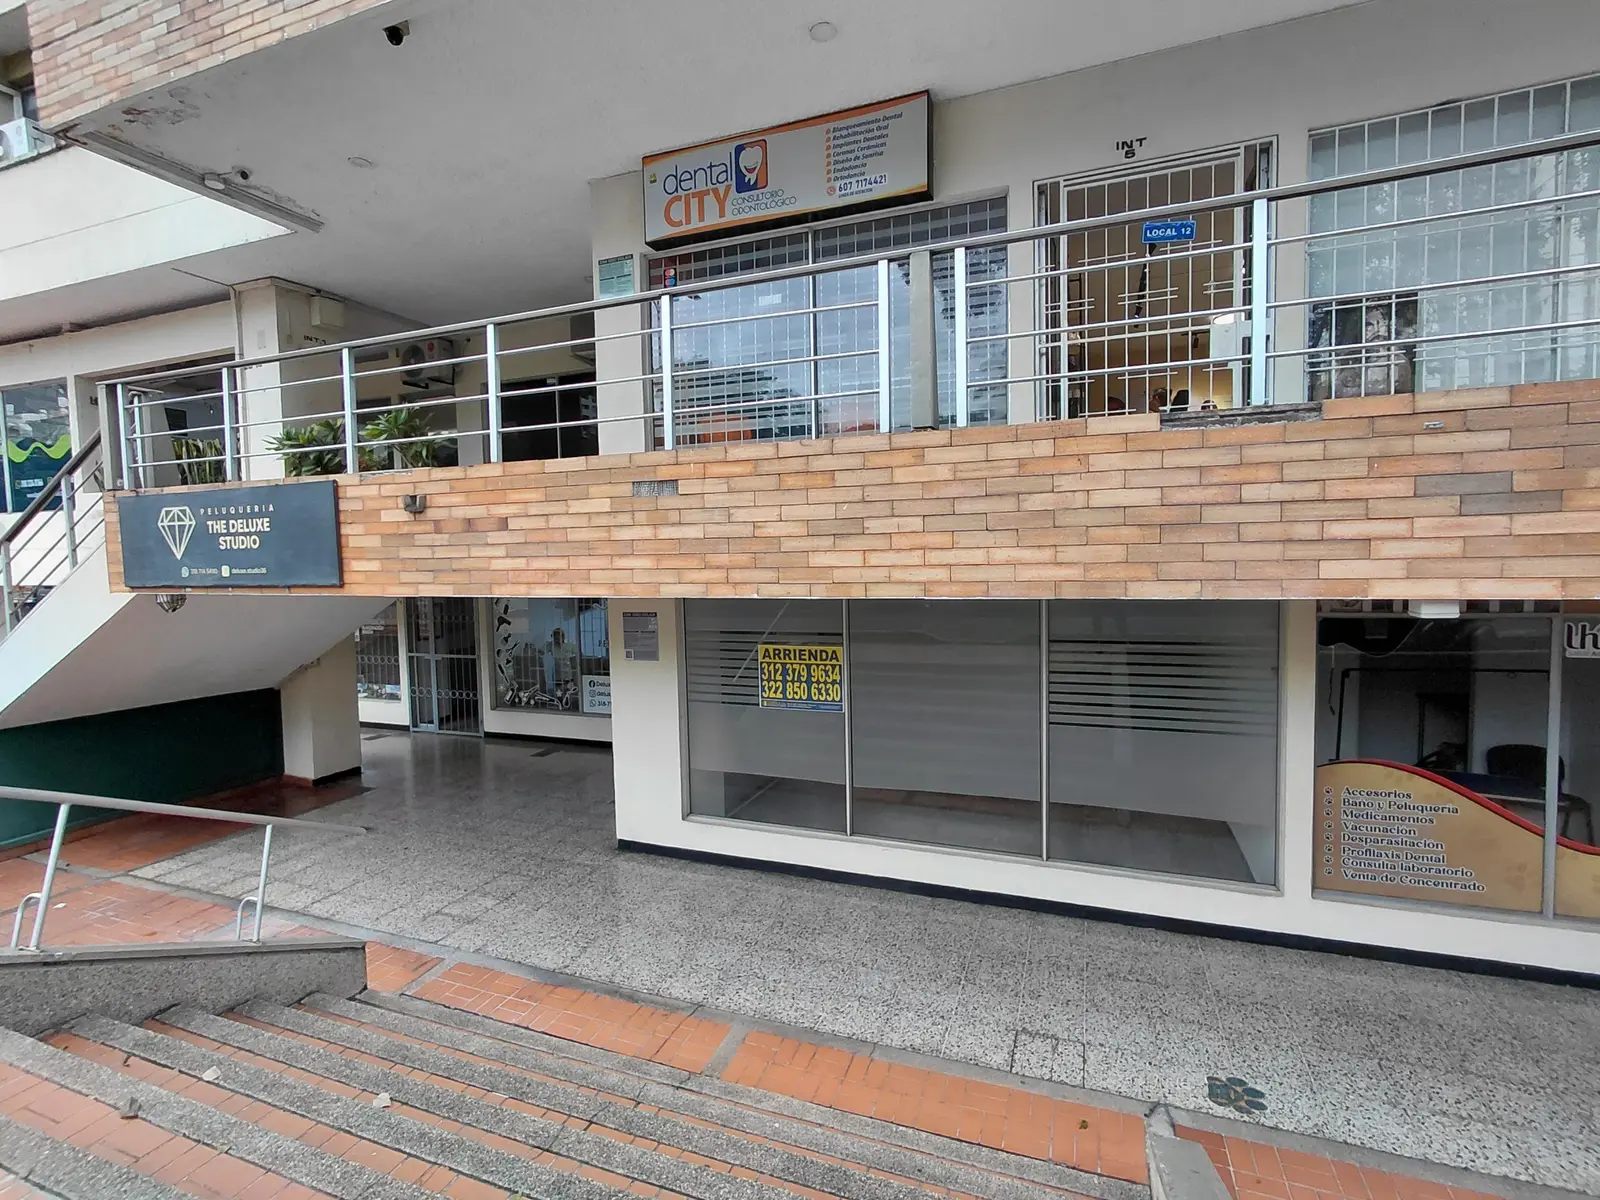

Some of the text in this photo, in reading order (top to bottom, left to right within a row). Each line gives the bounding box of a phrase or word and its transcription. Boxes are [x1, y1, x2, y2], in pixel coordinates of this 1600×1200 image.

[882, 111, 903, 123] Dental
[875, 123, 890, 132] Oral
[832, 132, 889, 149] Implantes Dentales
[1115, 136, 1147, 151] INT
[832, 140, 887, 158] Coronas Cerámicas
[1124, 148, 1136, 159] 5
[832, 150, 884, 166] Diseño de Sonrisa
[663, 151, 734, 196] dental
[833, 162, 868, 174] Endodoncia
[833, 170, 866, 182] Ortodoncia
[838, 181, 854, 193] 607
[663, 183, 733, 228] CITY
[731, 188, 785, 207] CONSULTORIO
[1146, 227, 1192, 237] LOCAL 12
[200, 503, 275, 515] PELUQUERIA
[206, 517, 271, 534] THE DELUXE
[219, 535, 260, 550] STUDIO
[762, 647, 839, 662] ARRIENDA
[761, 662, 841, 683] 312 379 9634
[762, 680, 841, 702] 322 850 6330
[1342, 787, 1412, 800] Accesorios
[1342, 797, 1374, 809] Baño
[1376, 801, 1385, 811] y
[1342, 809, 1435, 825] Medicamentos
[1342, 821, 1417, 837] Vacunación
[1342, 832, 1444, 850] Desparasitación
[1342, 846, 1446, 865] Profilaxis Dental
[1342, 857, 1474, 878] Consulta laboratorio
[1342, 869, 1486, 893] Venta de Concentrado
